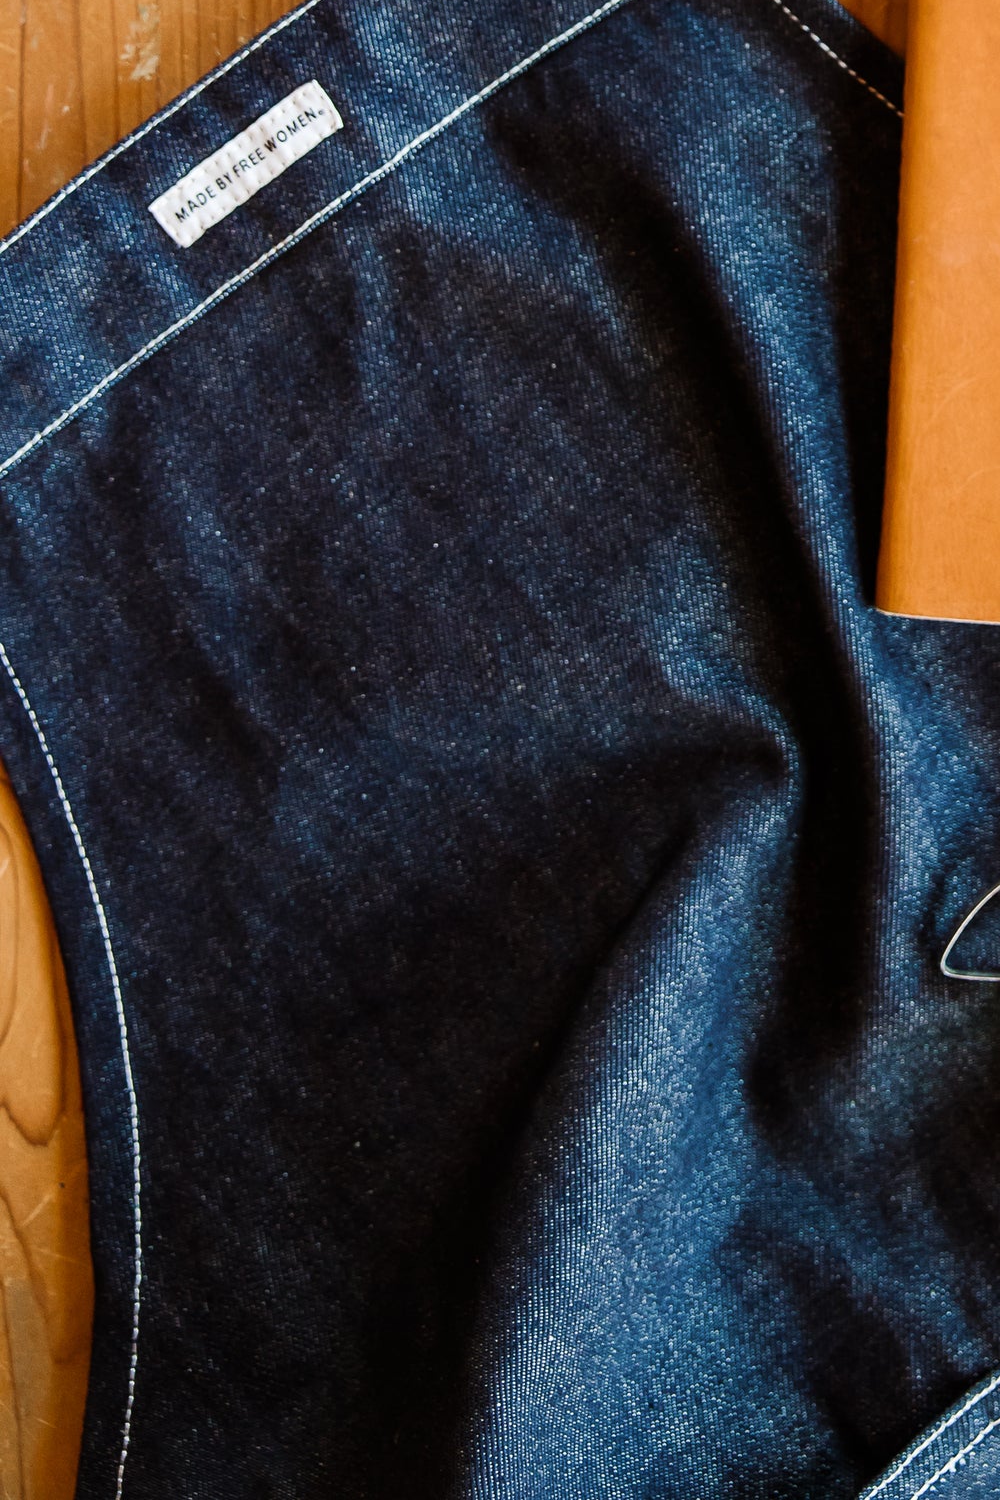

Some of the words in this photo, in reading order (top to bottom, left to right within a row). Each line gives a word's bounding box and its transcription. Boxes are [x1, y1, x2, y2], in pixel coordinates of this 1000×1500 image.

[175, 185, 216, 223] MADE
[215, 171, 233, 190] BY
[232, 147, 265, 177] FREE
